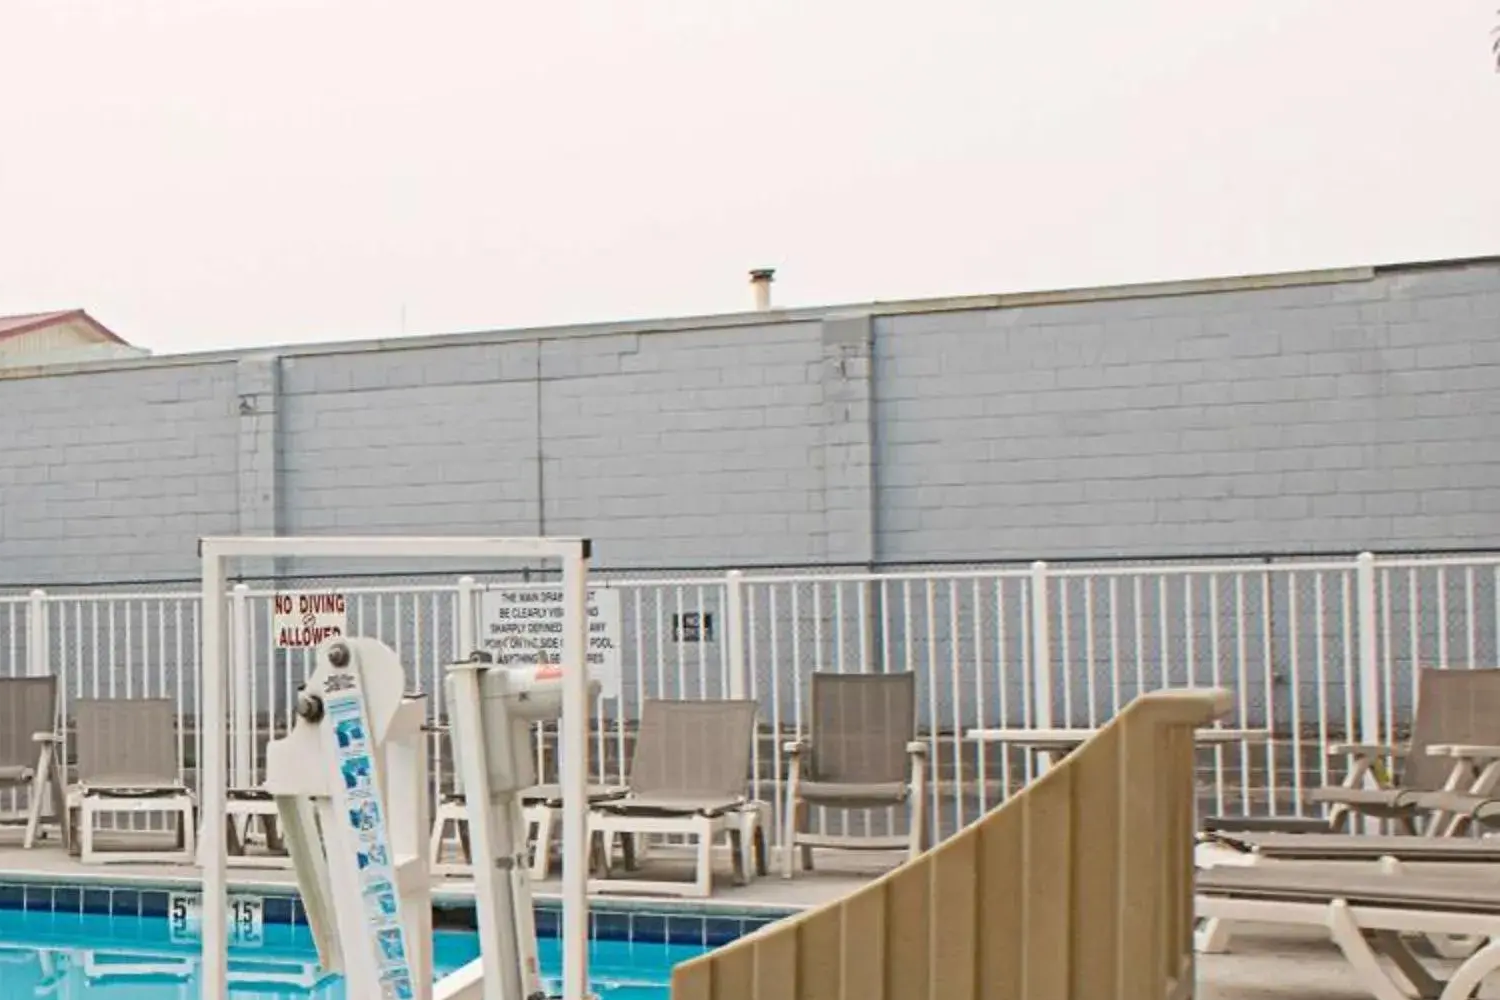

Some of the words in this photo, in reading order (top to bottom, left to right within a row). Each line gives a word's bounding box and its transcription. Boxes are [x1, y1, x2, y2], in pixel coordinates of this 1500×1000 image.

[275, 594, 293, 614] NO
[299, 593, 345, 613] DIVING
[499, 607, 511, 619] BE
[512, 607, 546, 619] CLEARLY
[490, 622, 526, 634] SHARPLY
[527, 623, 562, 633] DEFINED
[589, 637, 613, 649] POOL
